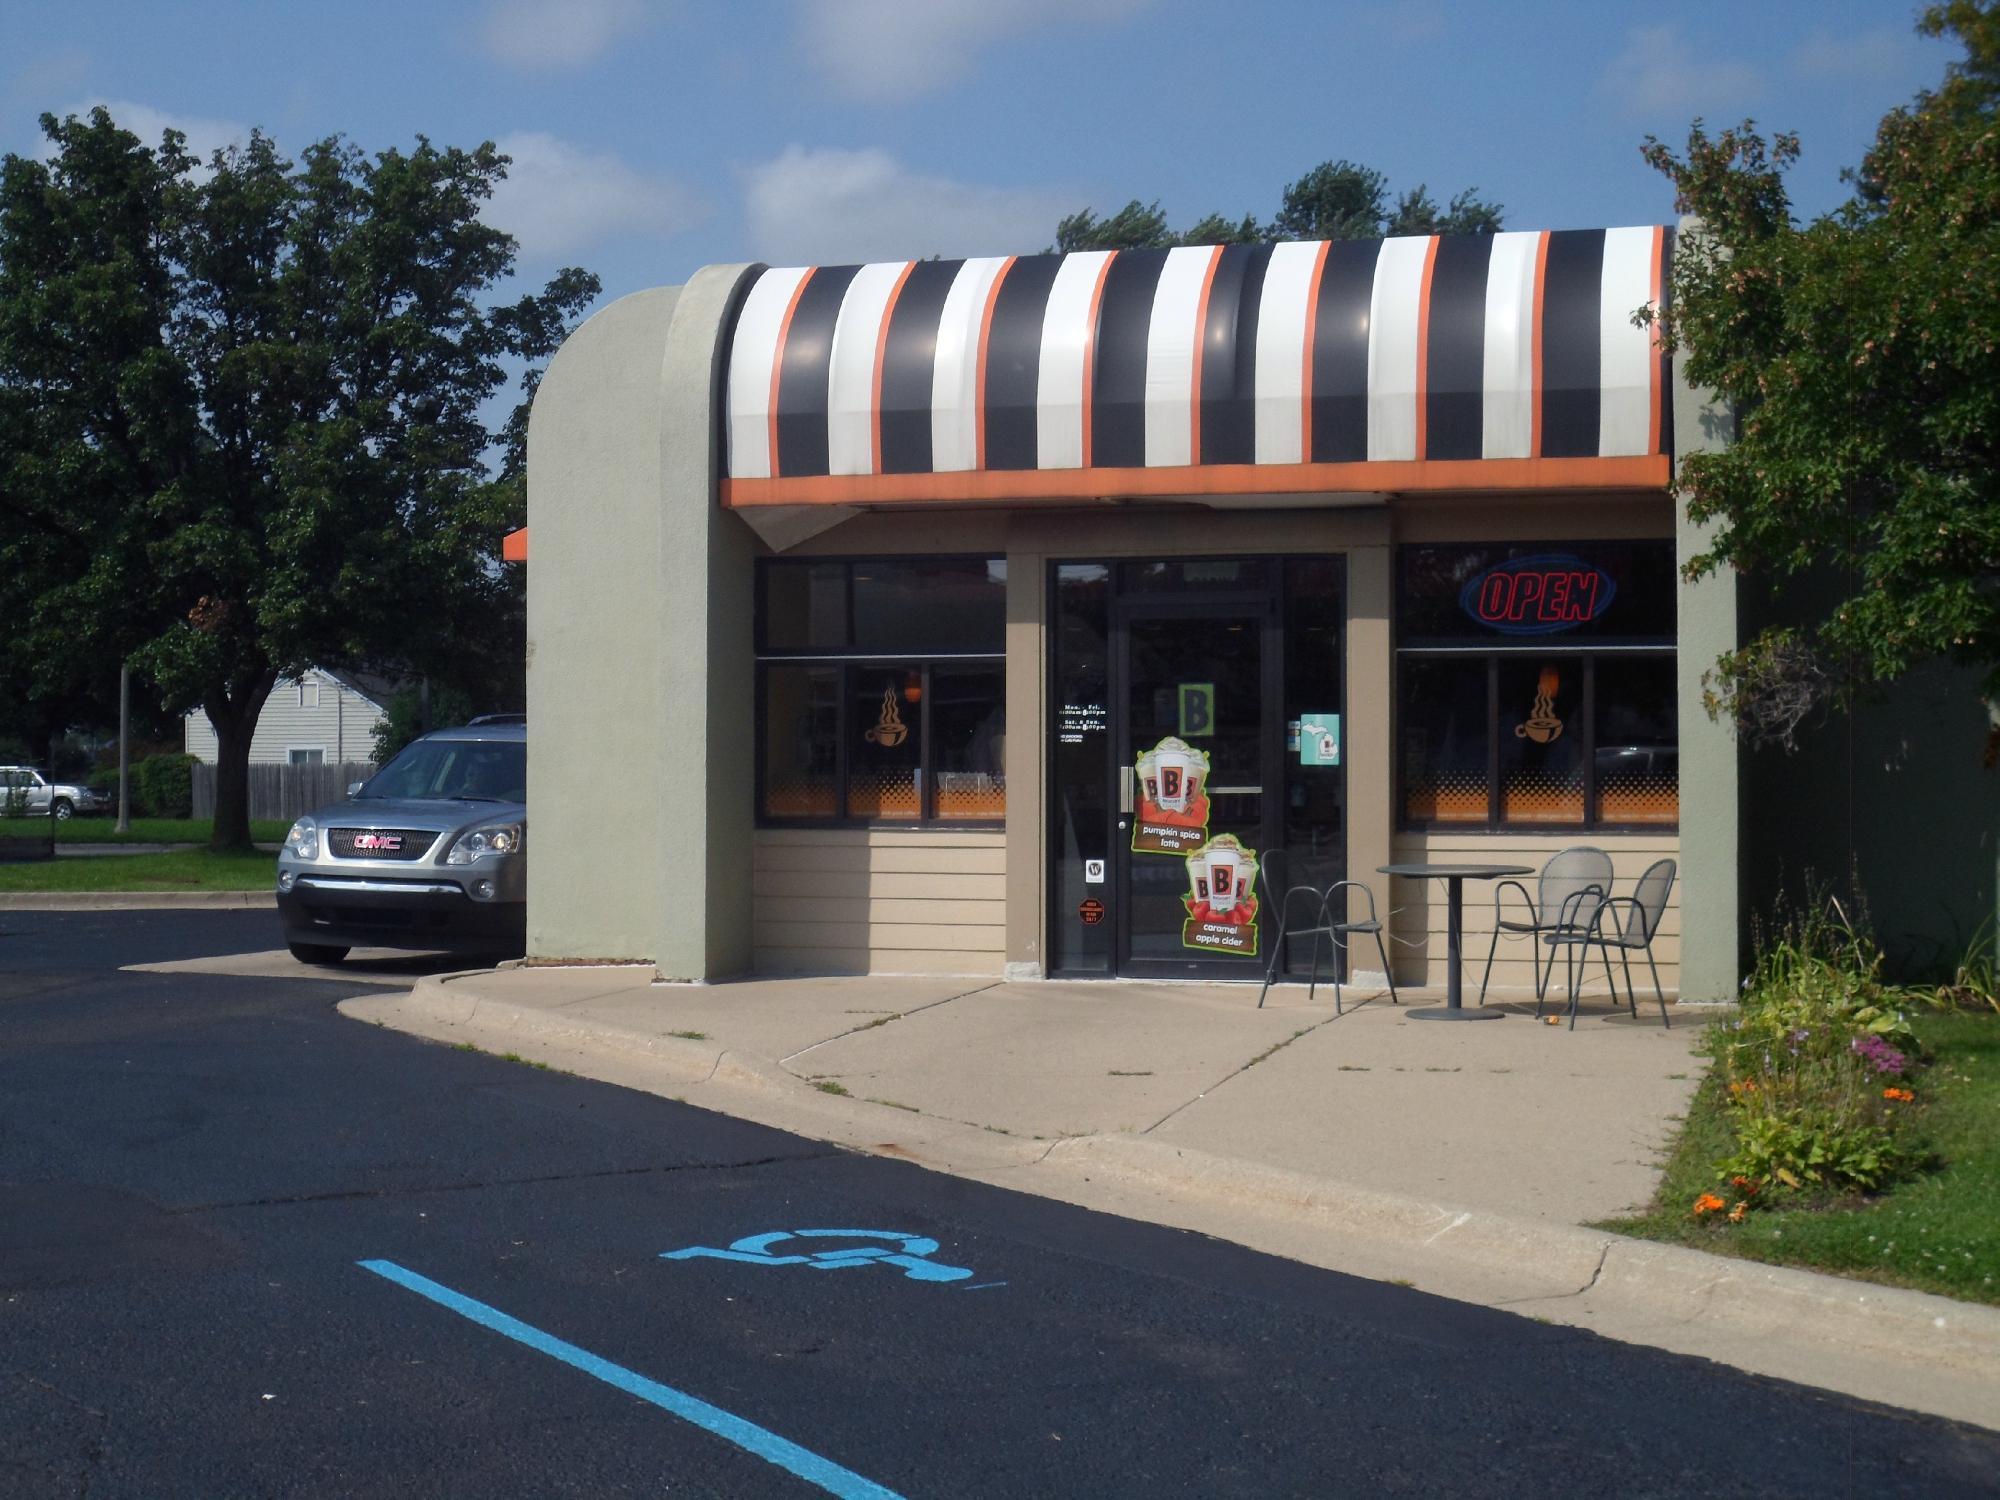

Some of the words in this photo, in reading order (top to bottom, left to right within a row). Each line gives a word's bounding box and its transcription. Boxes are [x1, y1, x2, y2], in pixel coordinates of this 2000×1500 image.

[1479, 572, 1598, 621] OPEN
[1184, 689, 1208, 731] B
[1164, 770, 1179, 797] B
[1142, 826, 1178, 837] pumpkin
[1180, 830, 1201, 840] spice
[354, 834, 402, 850] GMC
[1160, 838, 1180, 849] latte
[1215, 868, 1229, 893] B
[1203, 923, 1238, 935] caramel
[1195, 934, 1220, 944] apple
[1221, 936, 1243, 947] cider
